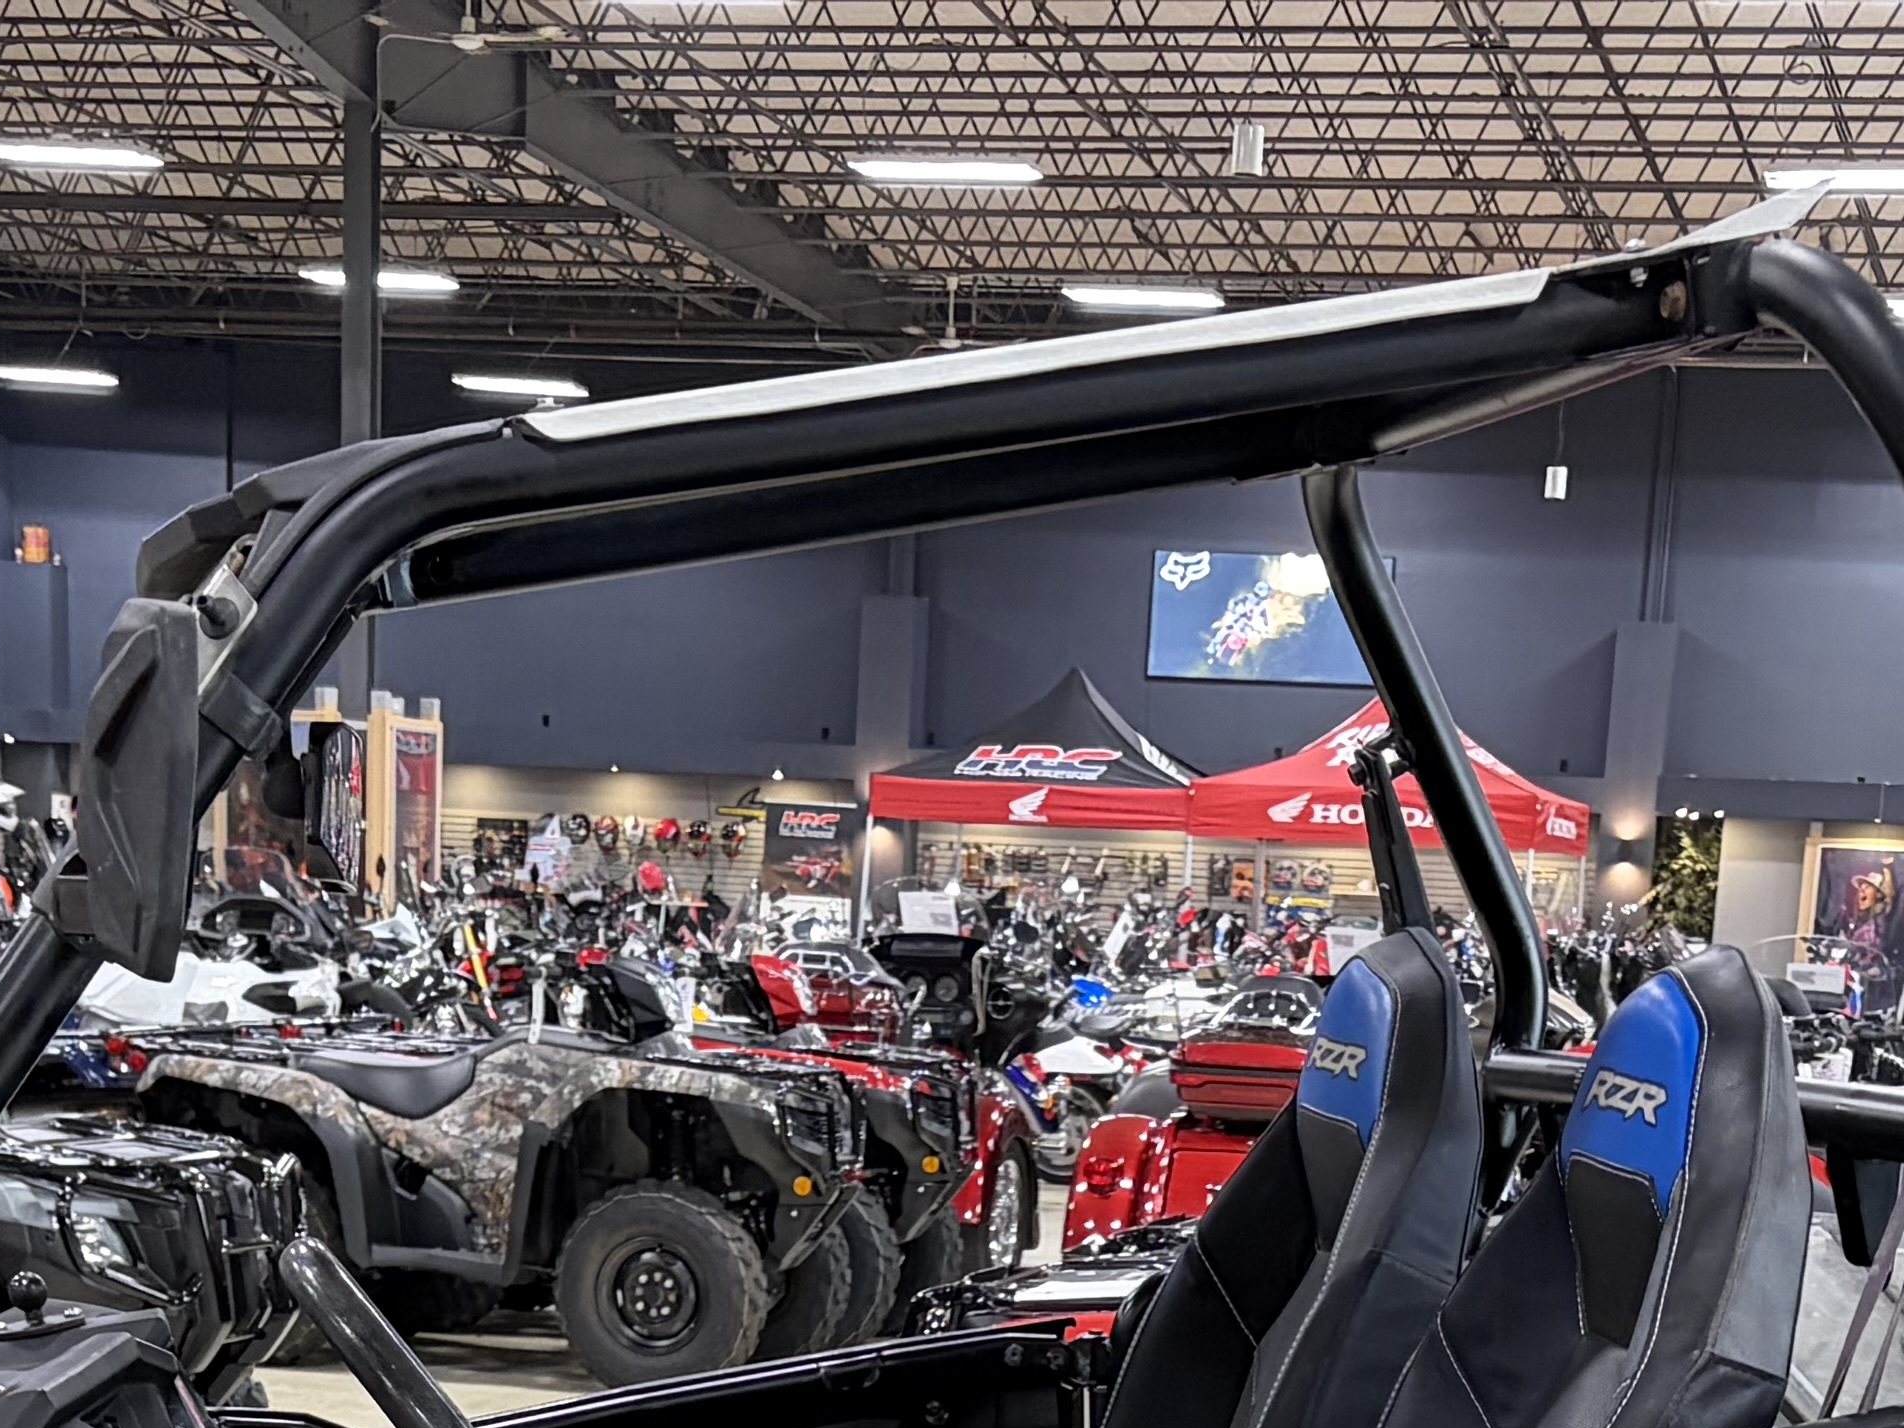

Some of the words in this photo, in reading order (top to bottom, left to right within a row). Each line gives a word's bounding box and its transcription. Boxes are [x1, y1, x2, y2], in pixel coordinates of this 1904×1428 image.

[956, 744, 1123, 775] HRC
[1306, 1037, 1367, 1080] RZR
[1585, 1069, 1668, 1127] RZR
